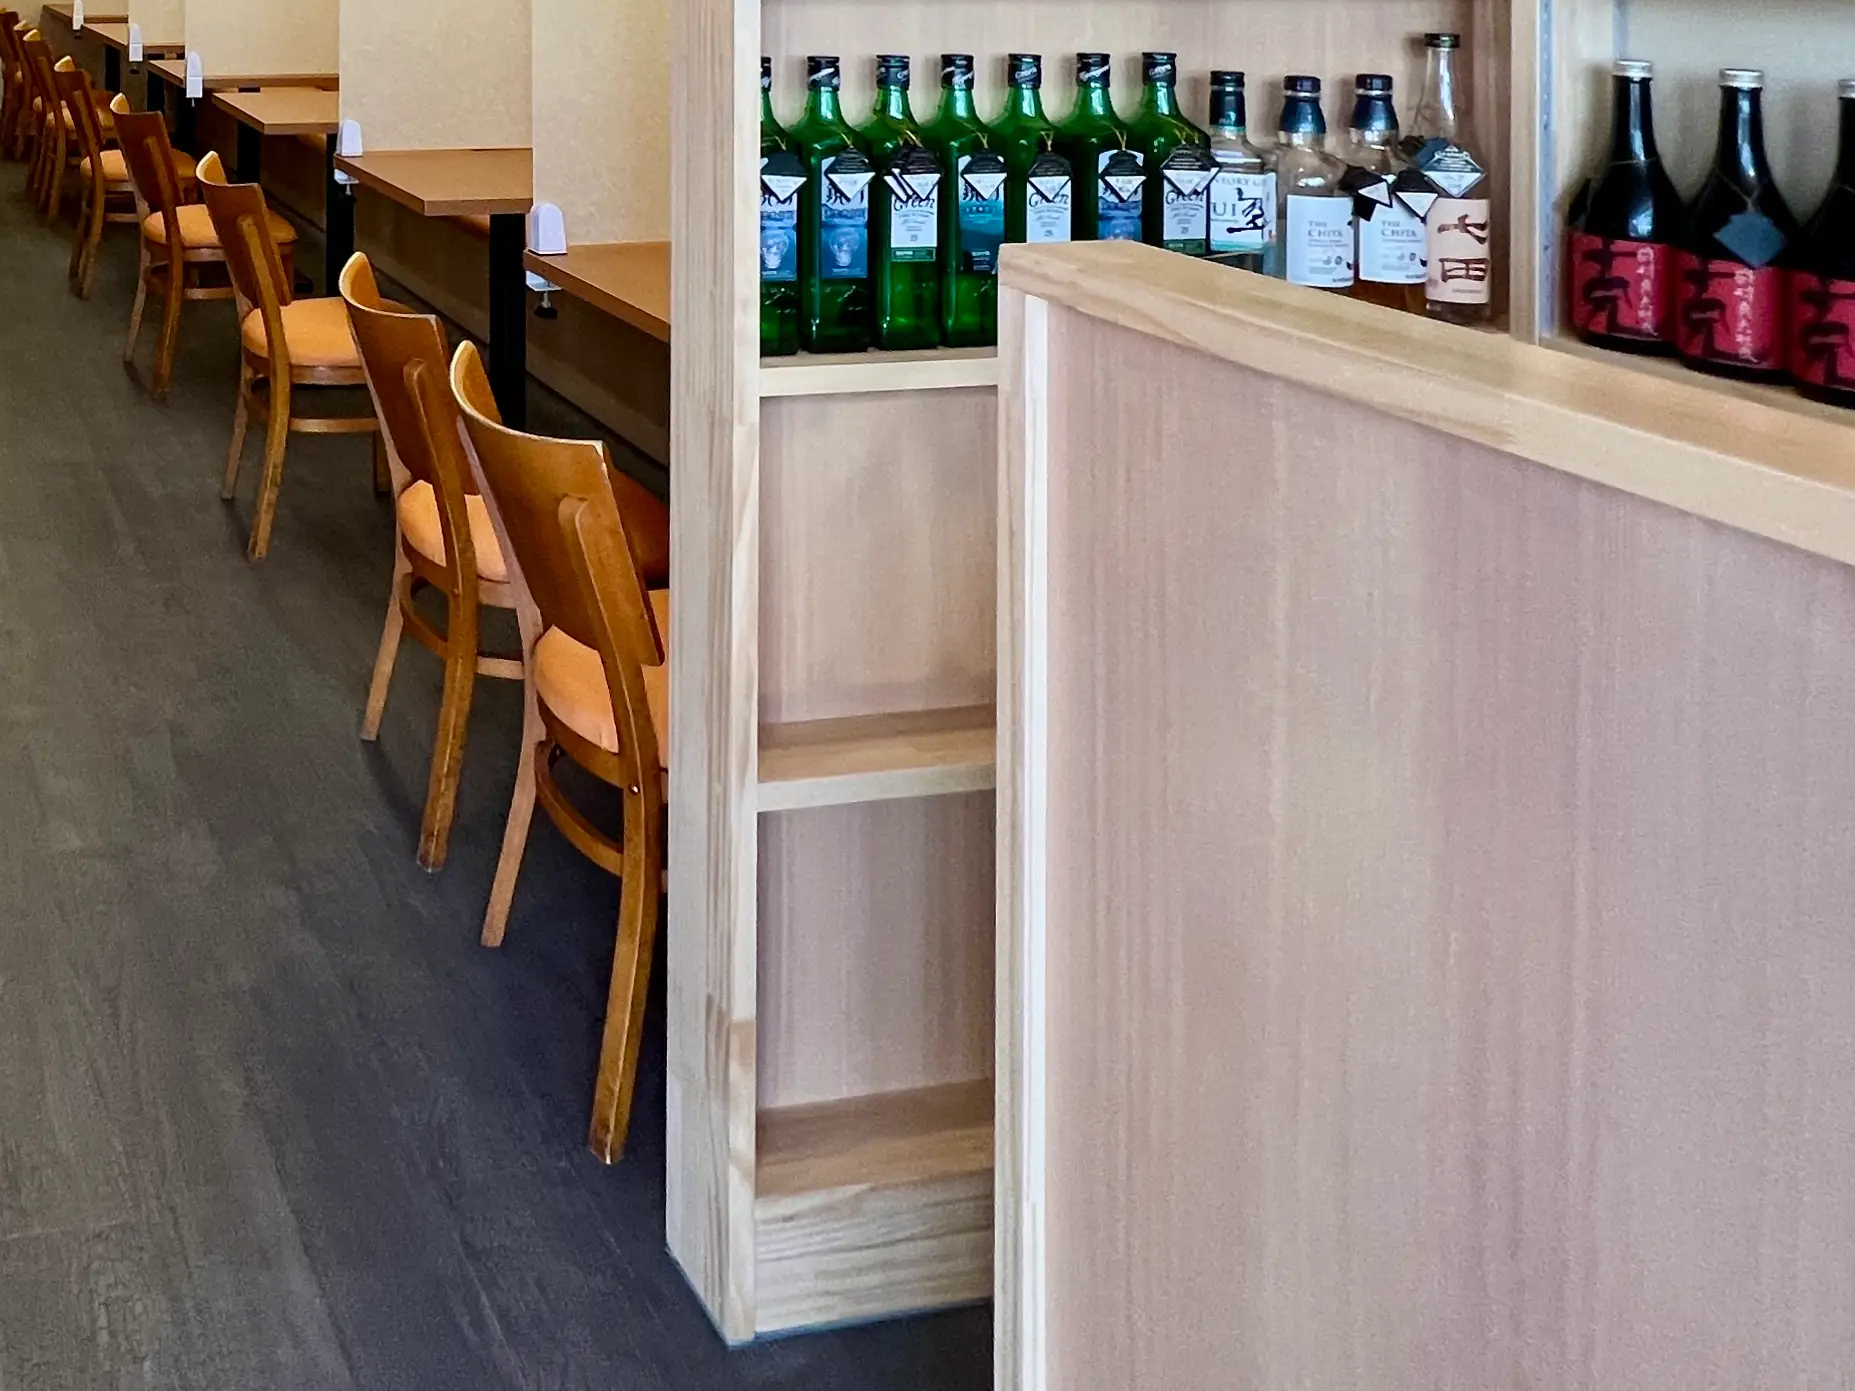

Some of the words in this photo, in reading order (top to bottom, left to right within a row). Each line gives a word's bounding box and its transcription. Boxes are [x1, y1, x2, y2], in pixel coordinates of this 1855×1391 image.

[1212, 201, 1237, 217] UI
[1307, 229, 1344, 238] CHITA
[1381, 229, 1418, 237] CHITA
